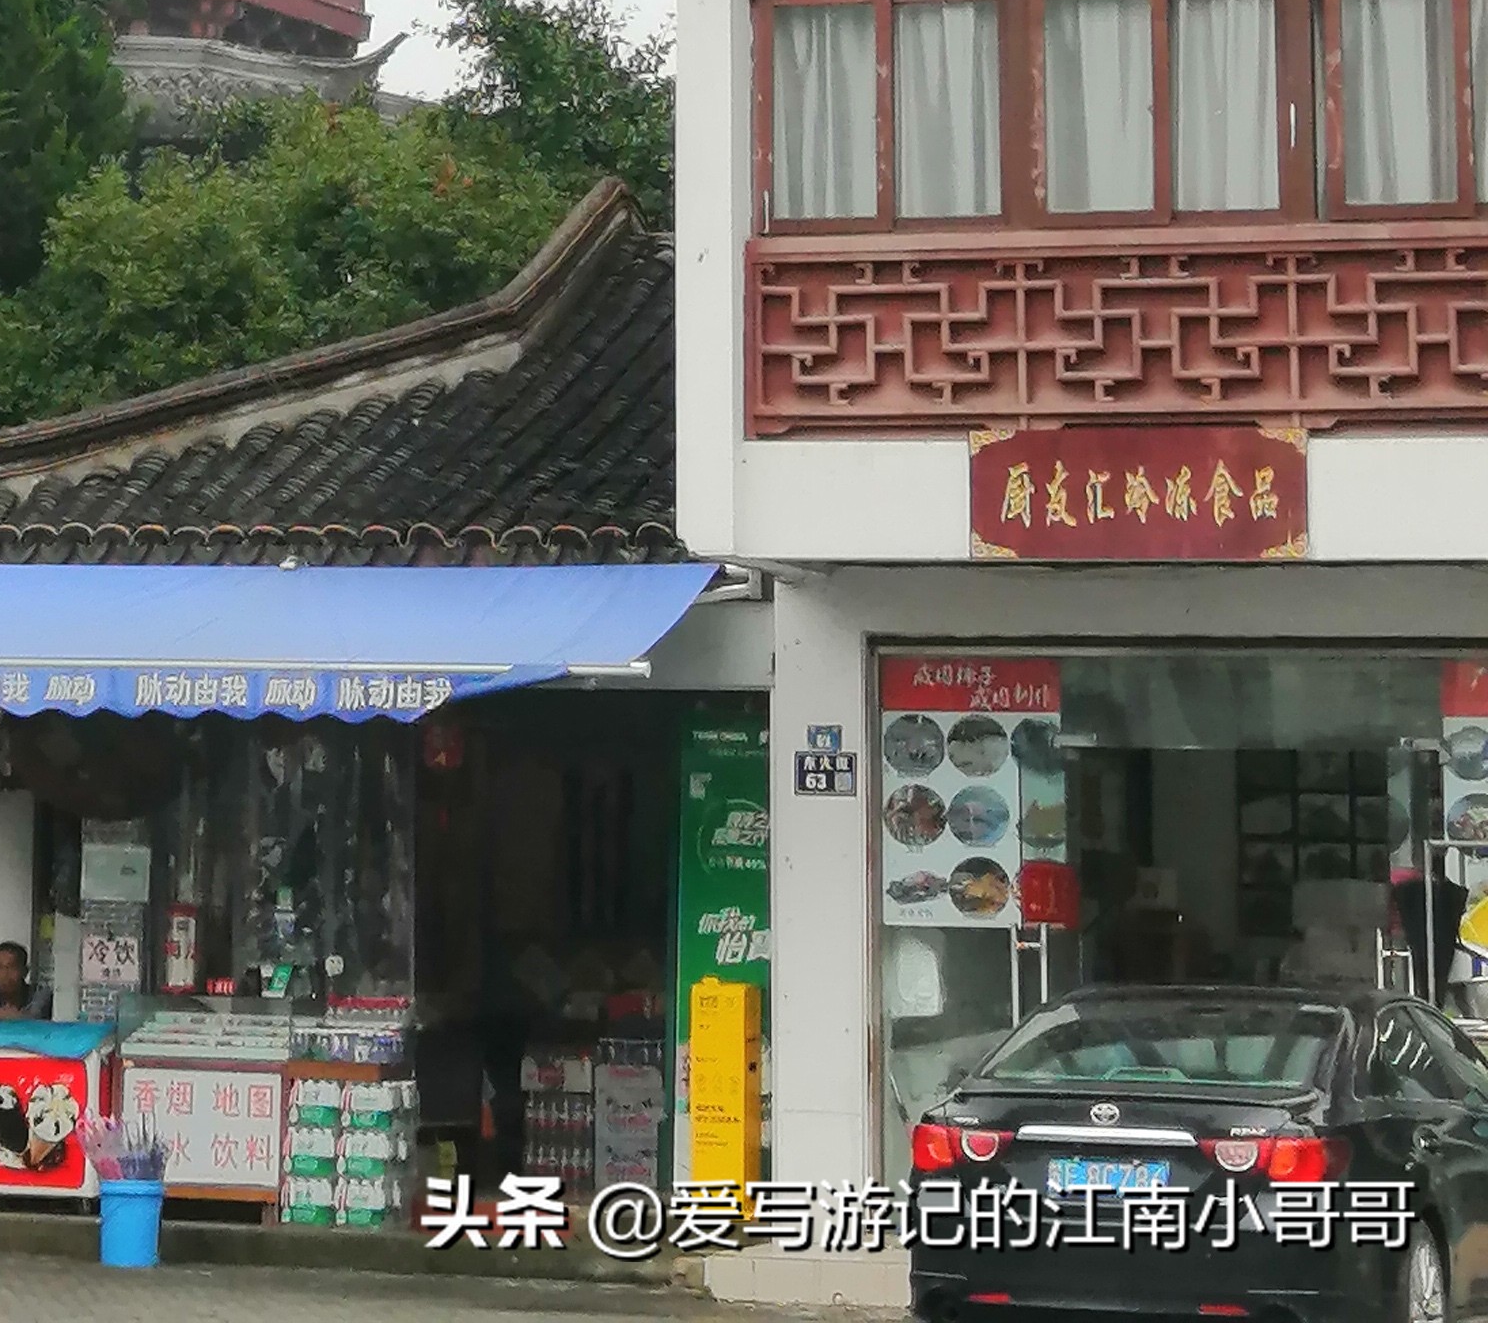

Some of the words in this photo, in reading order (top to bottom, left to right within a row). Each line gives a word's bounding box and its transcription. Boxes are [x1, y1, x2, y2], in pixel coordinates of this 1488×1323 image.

[1000, 458, 1280, 529] 厨友汇冷冻食品
[44, 672, 97, 706] 脉动
[134, 672, 251, 707] 脉动由我
[264, 674, 318, 711] 脉动
[805, 773, 827, 790] 63
[88, 939, 136, 966] 冷饮
[132, 1078, 194, 1117] 香烟
[212, 1081, 275, 1119] 地图
[211, 1131, 275, 1172] 饮料
